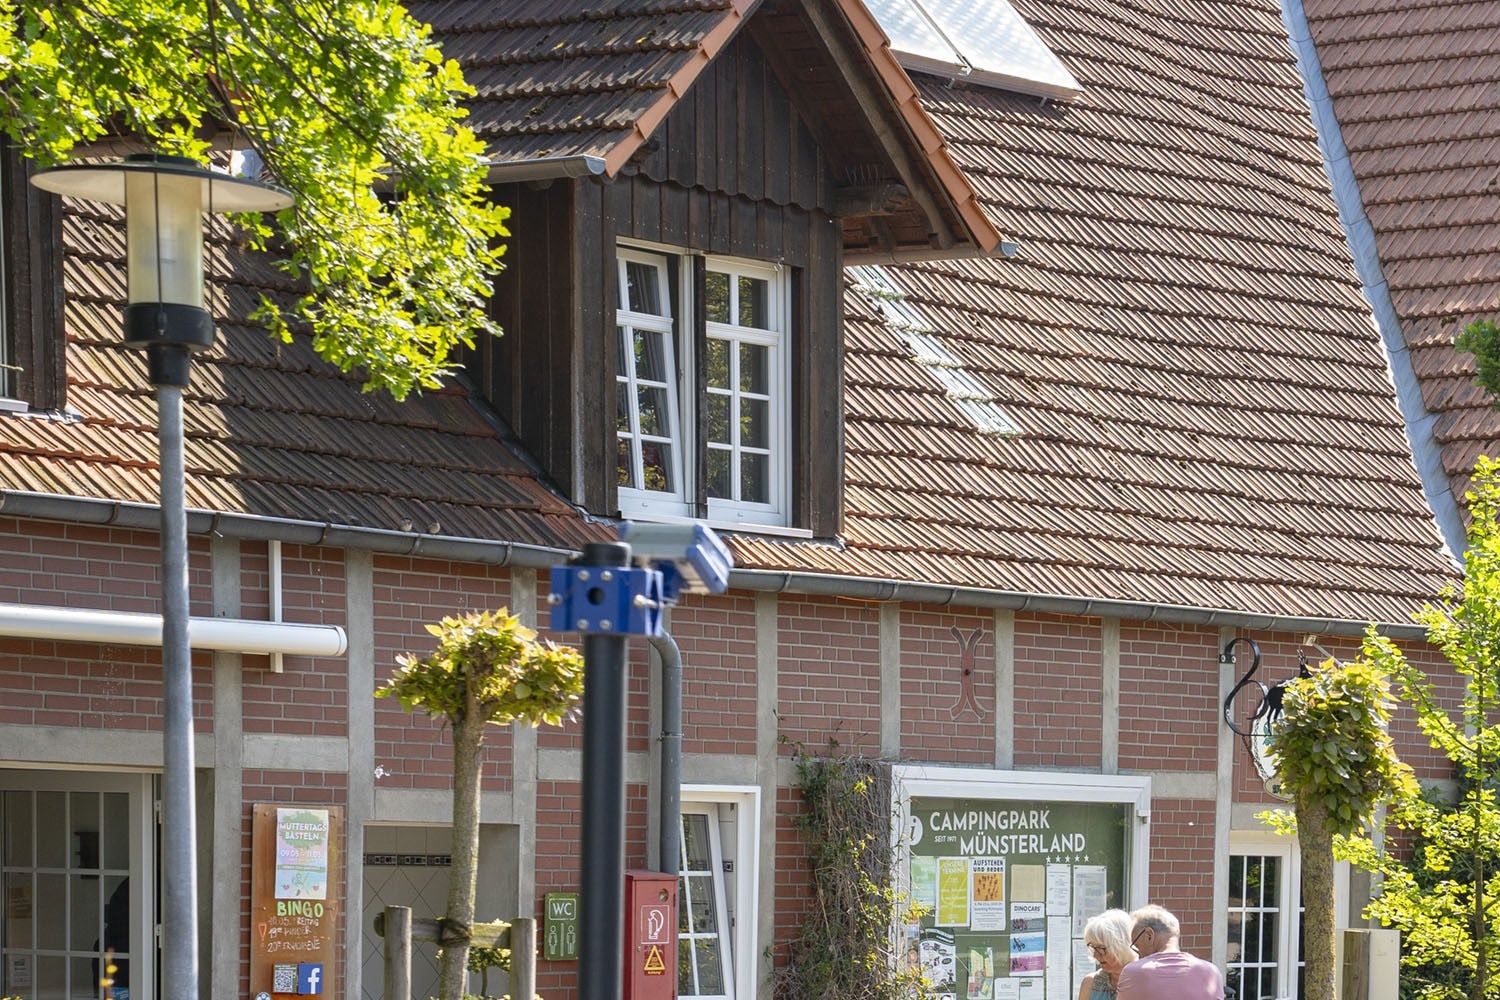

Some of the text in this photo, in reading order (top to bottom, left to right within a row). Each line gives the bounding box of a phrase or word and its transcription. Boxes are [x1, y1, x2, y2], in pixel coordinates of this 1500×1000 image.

[930, 810, 1050, 831] CAMPINGPARK
[280, 823, 327, 832] MUTTERTAGS
[285, 831, 319, 840] BASTELN
[934, 835, 946, 843] SEIT
[960, 832, 1086, 855] MÜNSTERLAND
[277, 901, 324, 918] BINGO
[553, 903, 572, 915] WC
